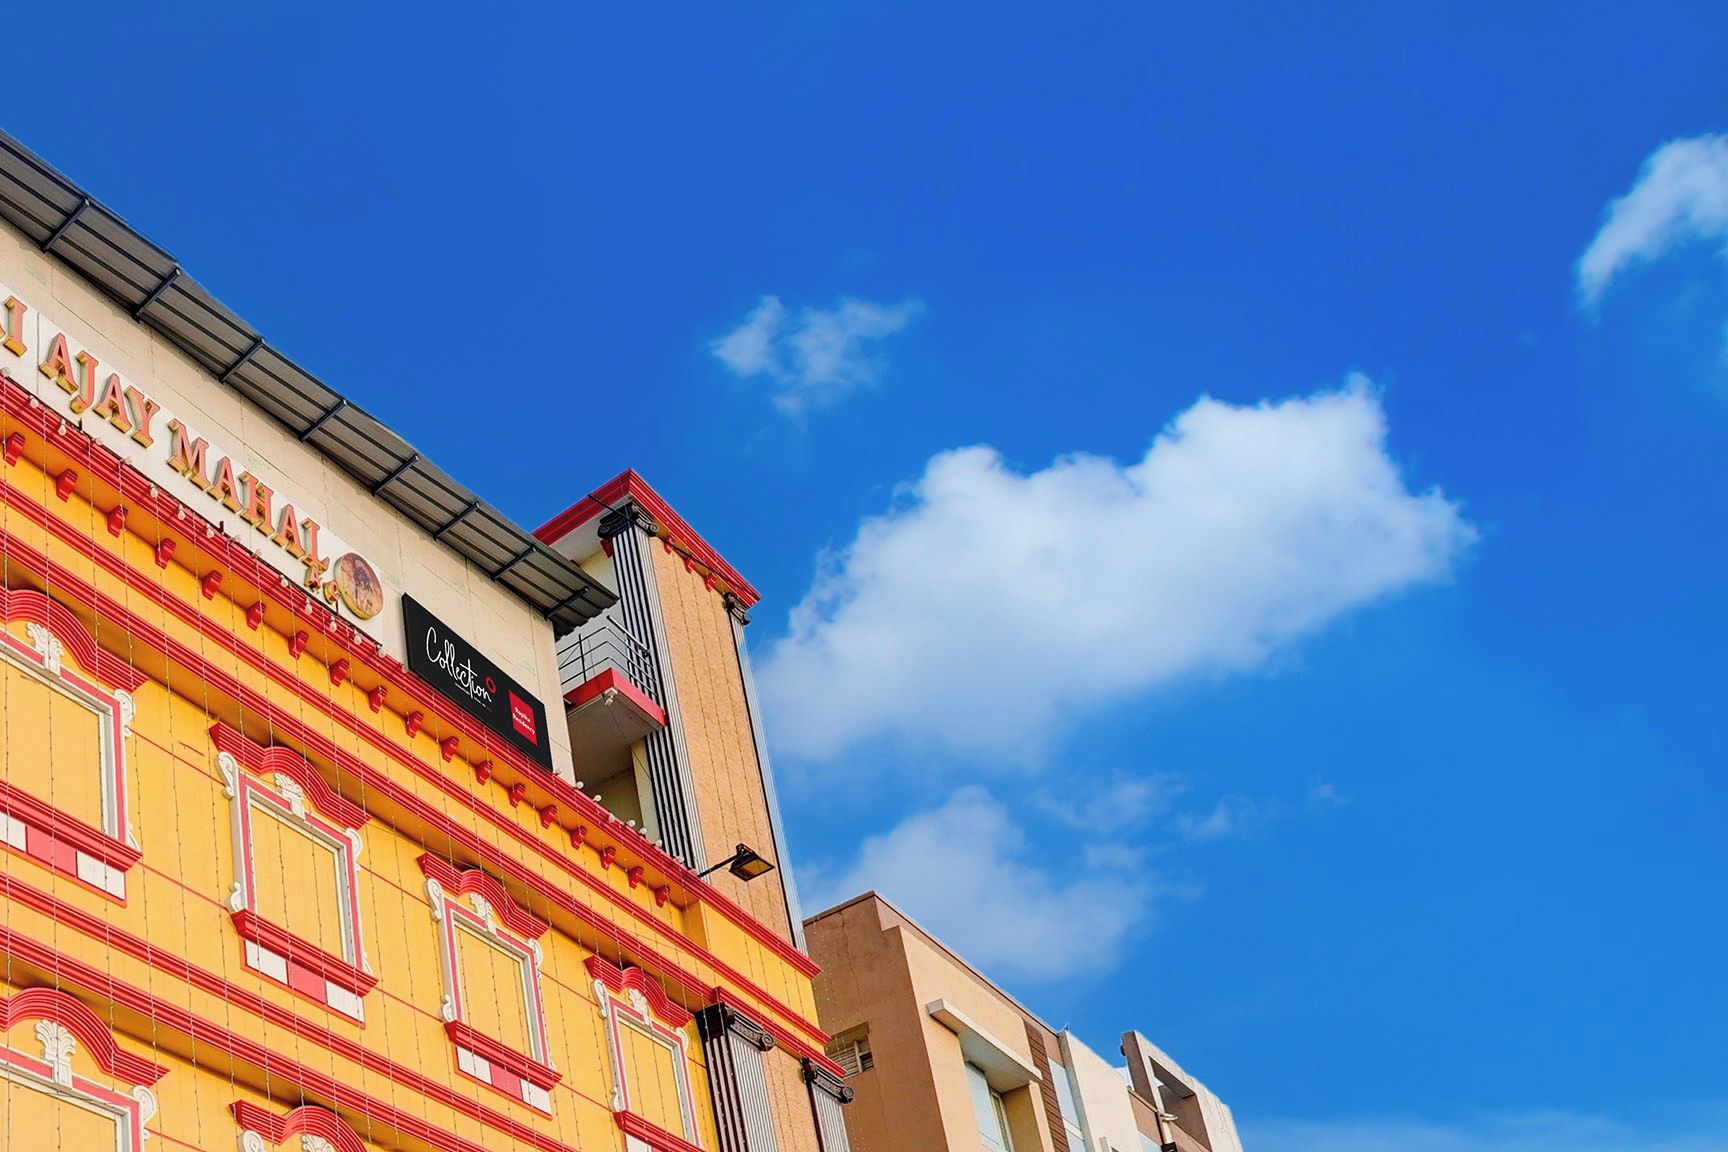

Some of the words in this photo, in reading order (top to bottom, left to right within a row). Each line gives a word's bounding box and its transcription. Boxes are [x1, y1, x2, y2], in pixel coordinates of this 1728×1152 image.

[39, 332, 160, 448] AJAY
[167, 418, 329, 571] MAHAL
[426, 626, 492, 702] Collection
